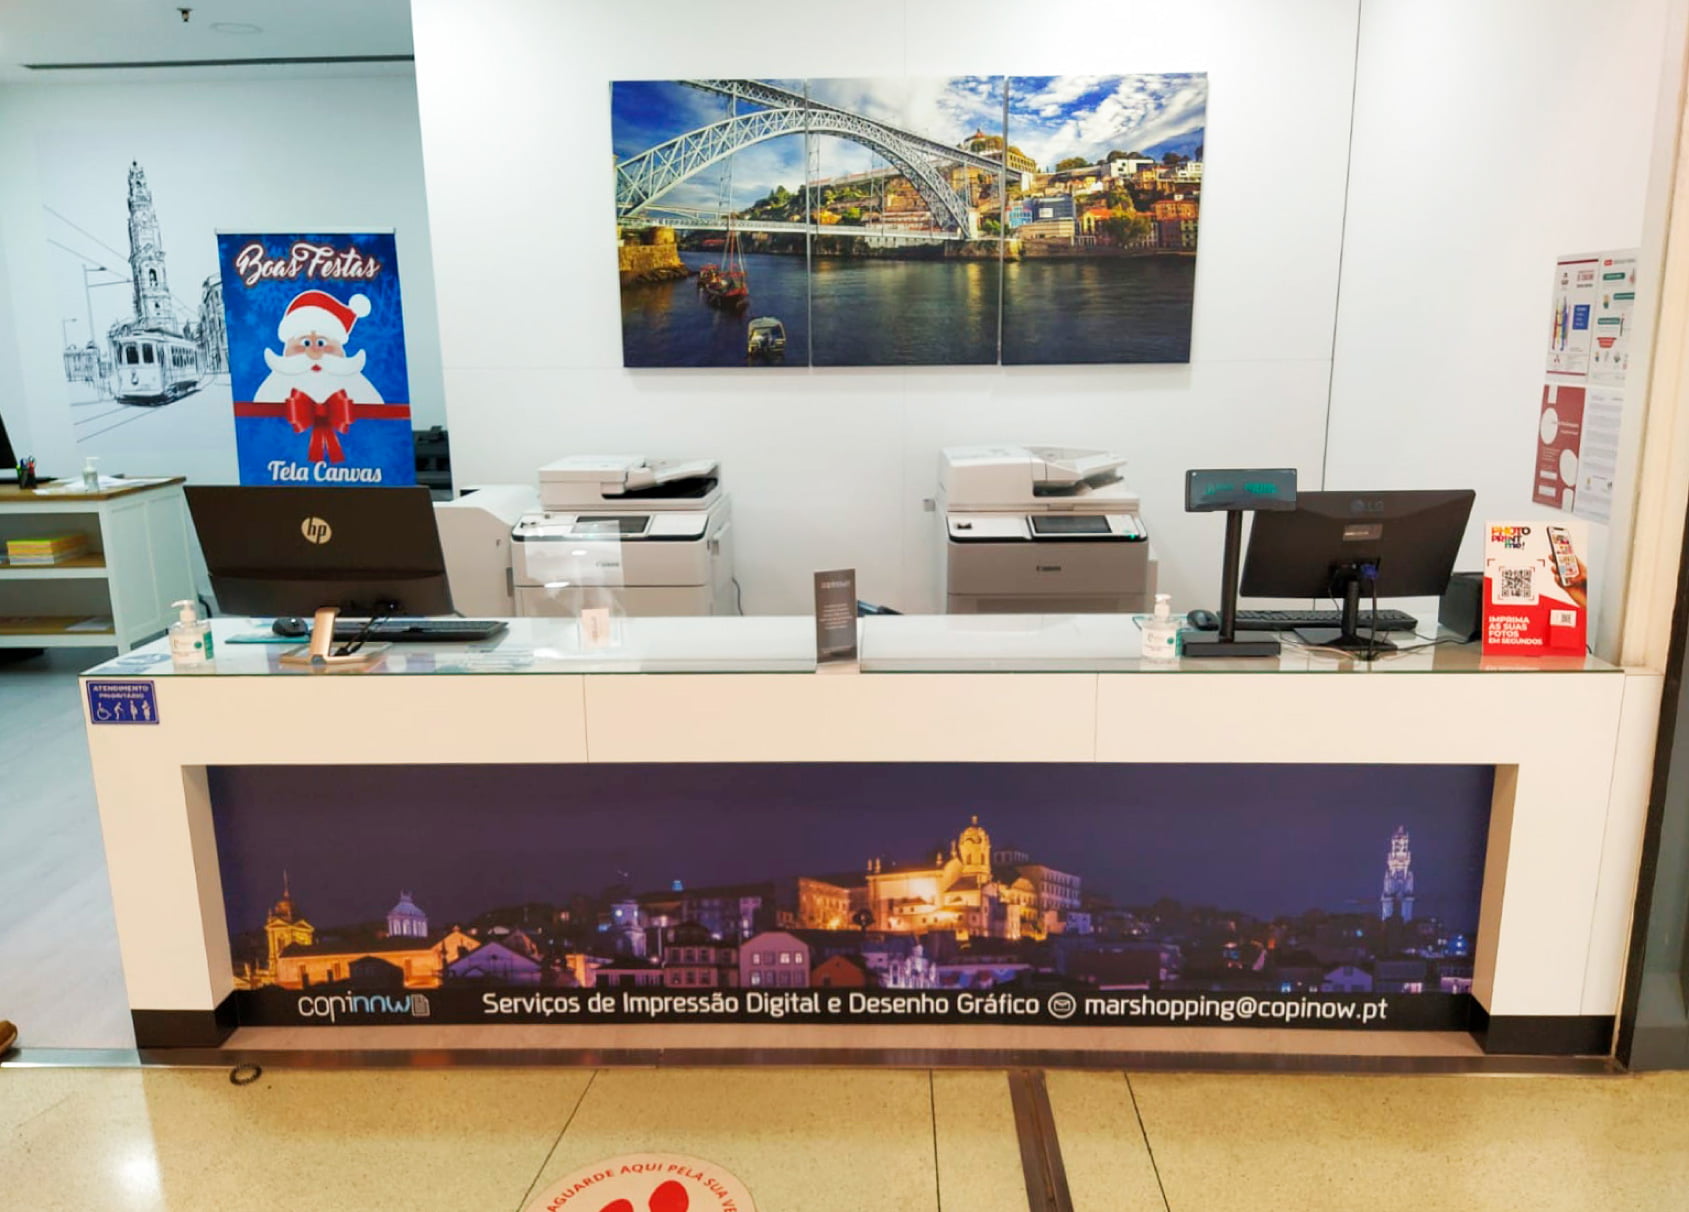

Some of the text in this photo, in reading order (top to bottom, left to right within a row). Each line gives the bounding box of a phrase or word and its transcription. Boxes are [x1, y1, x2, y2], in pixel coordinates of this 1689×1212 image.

[235, 242, 381, 287] Boas Festas
[267, 460, 383, 483] Tela Canvas
[305, 517, 329, 544] hp
[1488, 616, 1531, 624] IMPRIMA
[1488, 623, 1528, 632] AS SUAS
[1488, 630, 1520, 638] FOTOS
[482, 992, 1389, 1023] Serviços de Impressão Digital e Desenho Gráfico marshopping@copinow.pt
[546, 1162, 738, 1212] AGUARDE AQUI PELA SUA VE
